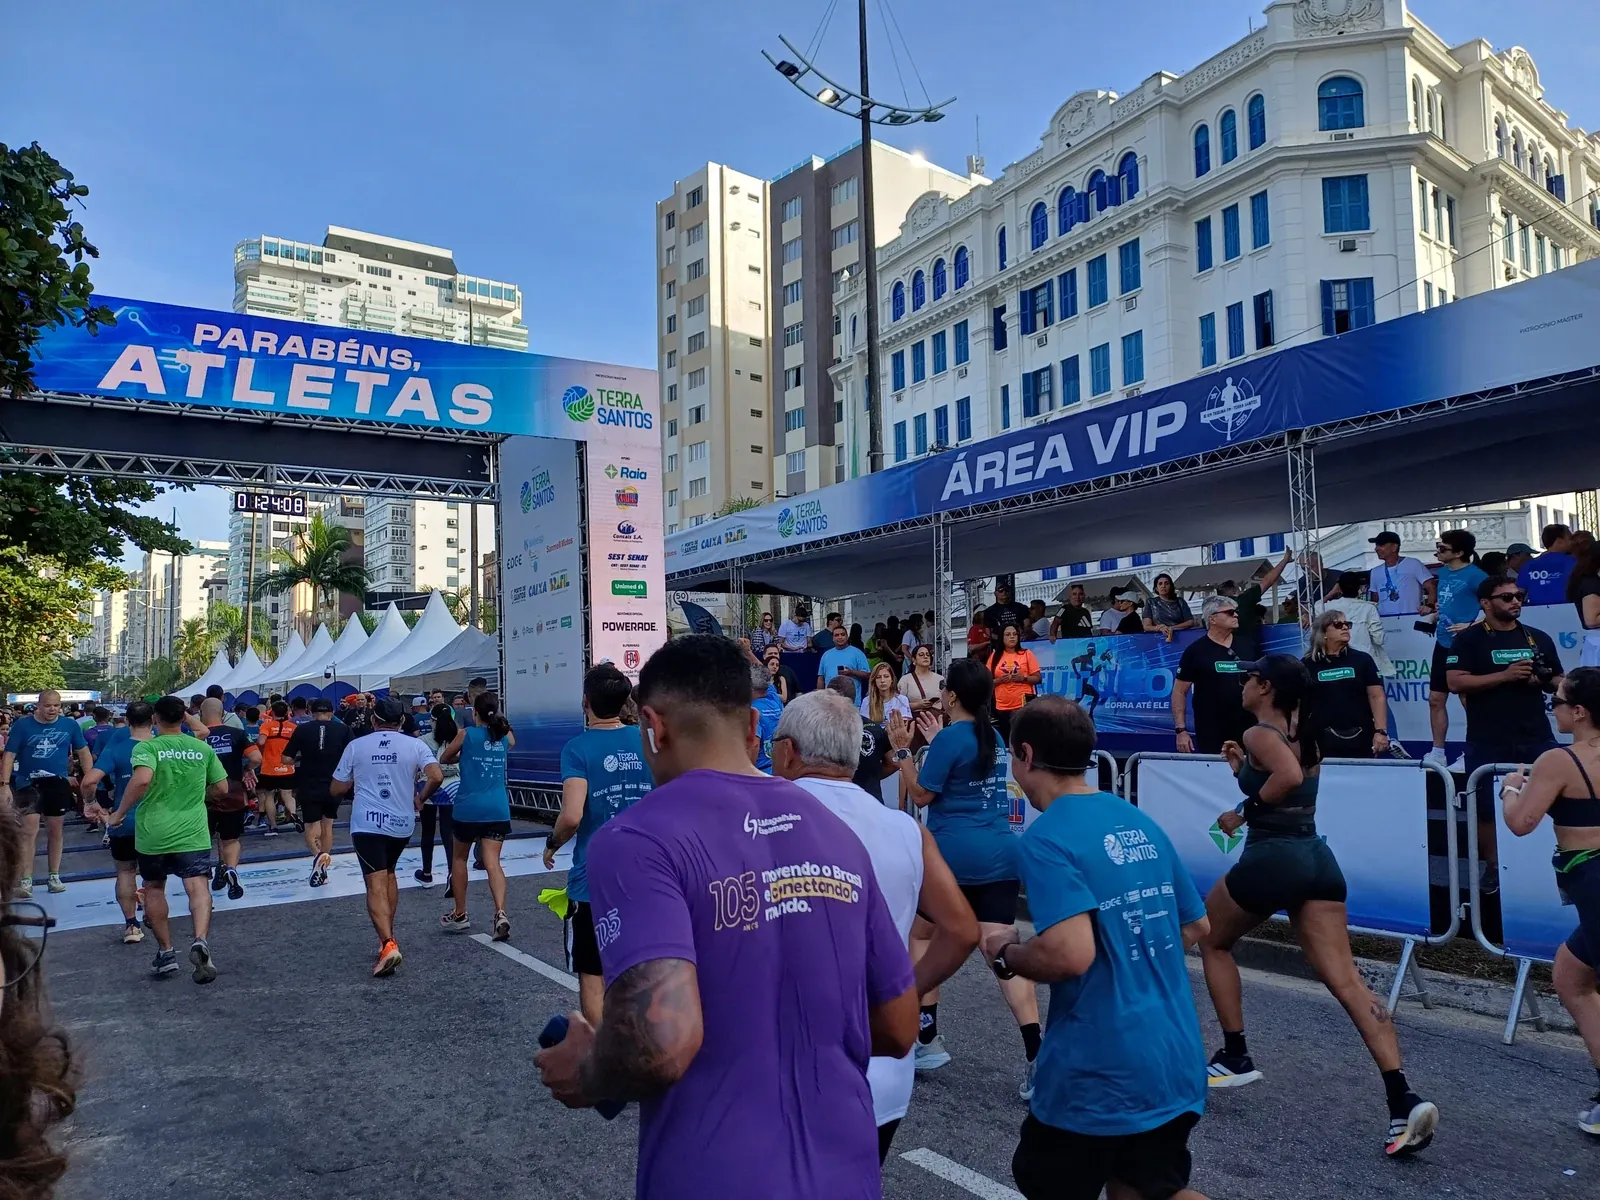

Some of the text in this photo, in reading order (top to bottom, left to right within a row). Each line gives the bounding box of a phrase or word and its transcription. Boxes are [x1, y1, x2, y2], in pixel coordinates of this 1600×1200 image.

[193, 323, 421, 372] PARABÉNS,
[97, 344, 494, 425] ATLETAS
[596, 388, 644, 410] TERRA
[597, 407, 653, 430] SANTOS
[940, 399, 1188, 502] ÁREA VIP
[531, 469, 551, 493] TERRA
[620, 466, 648, 480] Raia
[532, 484, 555, 510] SANTOS
[795, 499, 822, 520] TERRA
[795, 514, 828, 536] SANTOS
[700, 535, 722, 550] CAIXA
[608, 553, 649, 562] SEST SENAT
[1528, 570, 1549, 580] 100
[528, 580, 548, 598] CAIXA
[675, 592, 686, 600] 50
[1388, 659, 1431, 680] ERRA
[1104, 699, 1170, 709] CORRA ATÉ ELE
[157, 748, 204, 762] pelotão
[617, 752, 639, 762] TERRA
[618, 761, 643, 771] SANTOS
[1116, 829, 1149, 847] TERRA
[1123, 843, 1159, 864] SANTOS
[761, 861, 863, 889] movendo o Brasil
[709, 870, 760, 931] 105
[764, 889, 771, 902] e
[851, 890, 859, 903] o
[1099, 896, 1122, 912] EDGE
